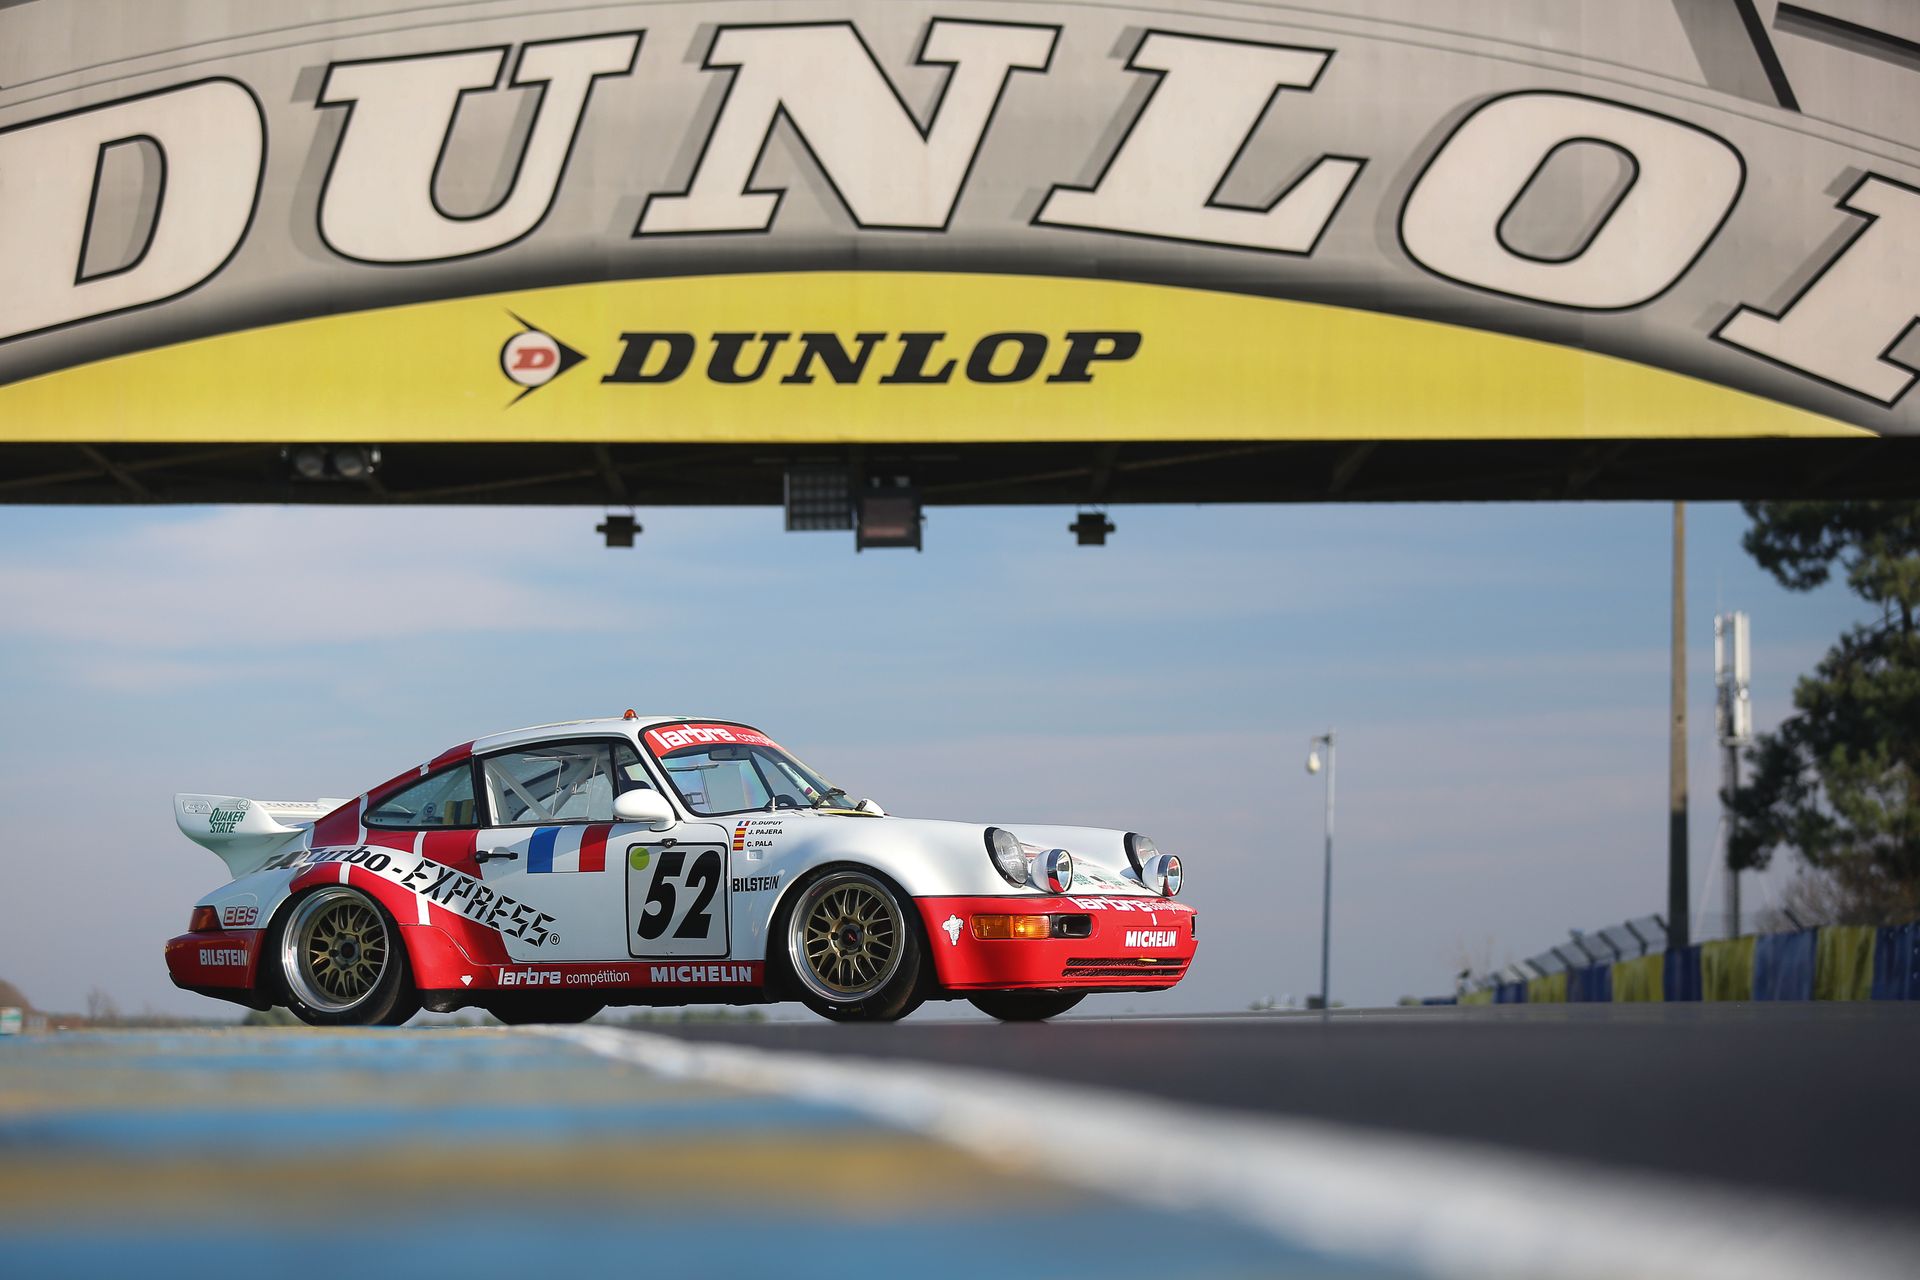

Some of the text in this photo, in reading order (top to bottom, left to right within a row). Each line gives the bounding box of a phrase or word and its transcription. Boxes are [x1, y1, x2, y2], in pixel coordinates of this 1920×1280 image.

[600, 331, 1143, 385] DUNLOP
[648, 724, 737, 750] larbre
[209, 807, 246, 824] QUAKER
[732, 875, 780, 893] BILSTEIN
[637, 849, 722, 940] 52
[1066, 896, 1154, 913] larbre
[222, 905, 259, 927] BBS
[1125, 930, 1177, 947] MICHELIN
[199, 948, 249, 967] BILSTEIN
[497, 967, 630, 986] larbre compétition
[650, 965, 752, 983] MICHELIN
